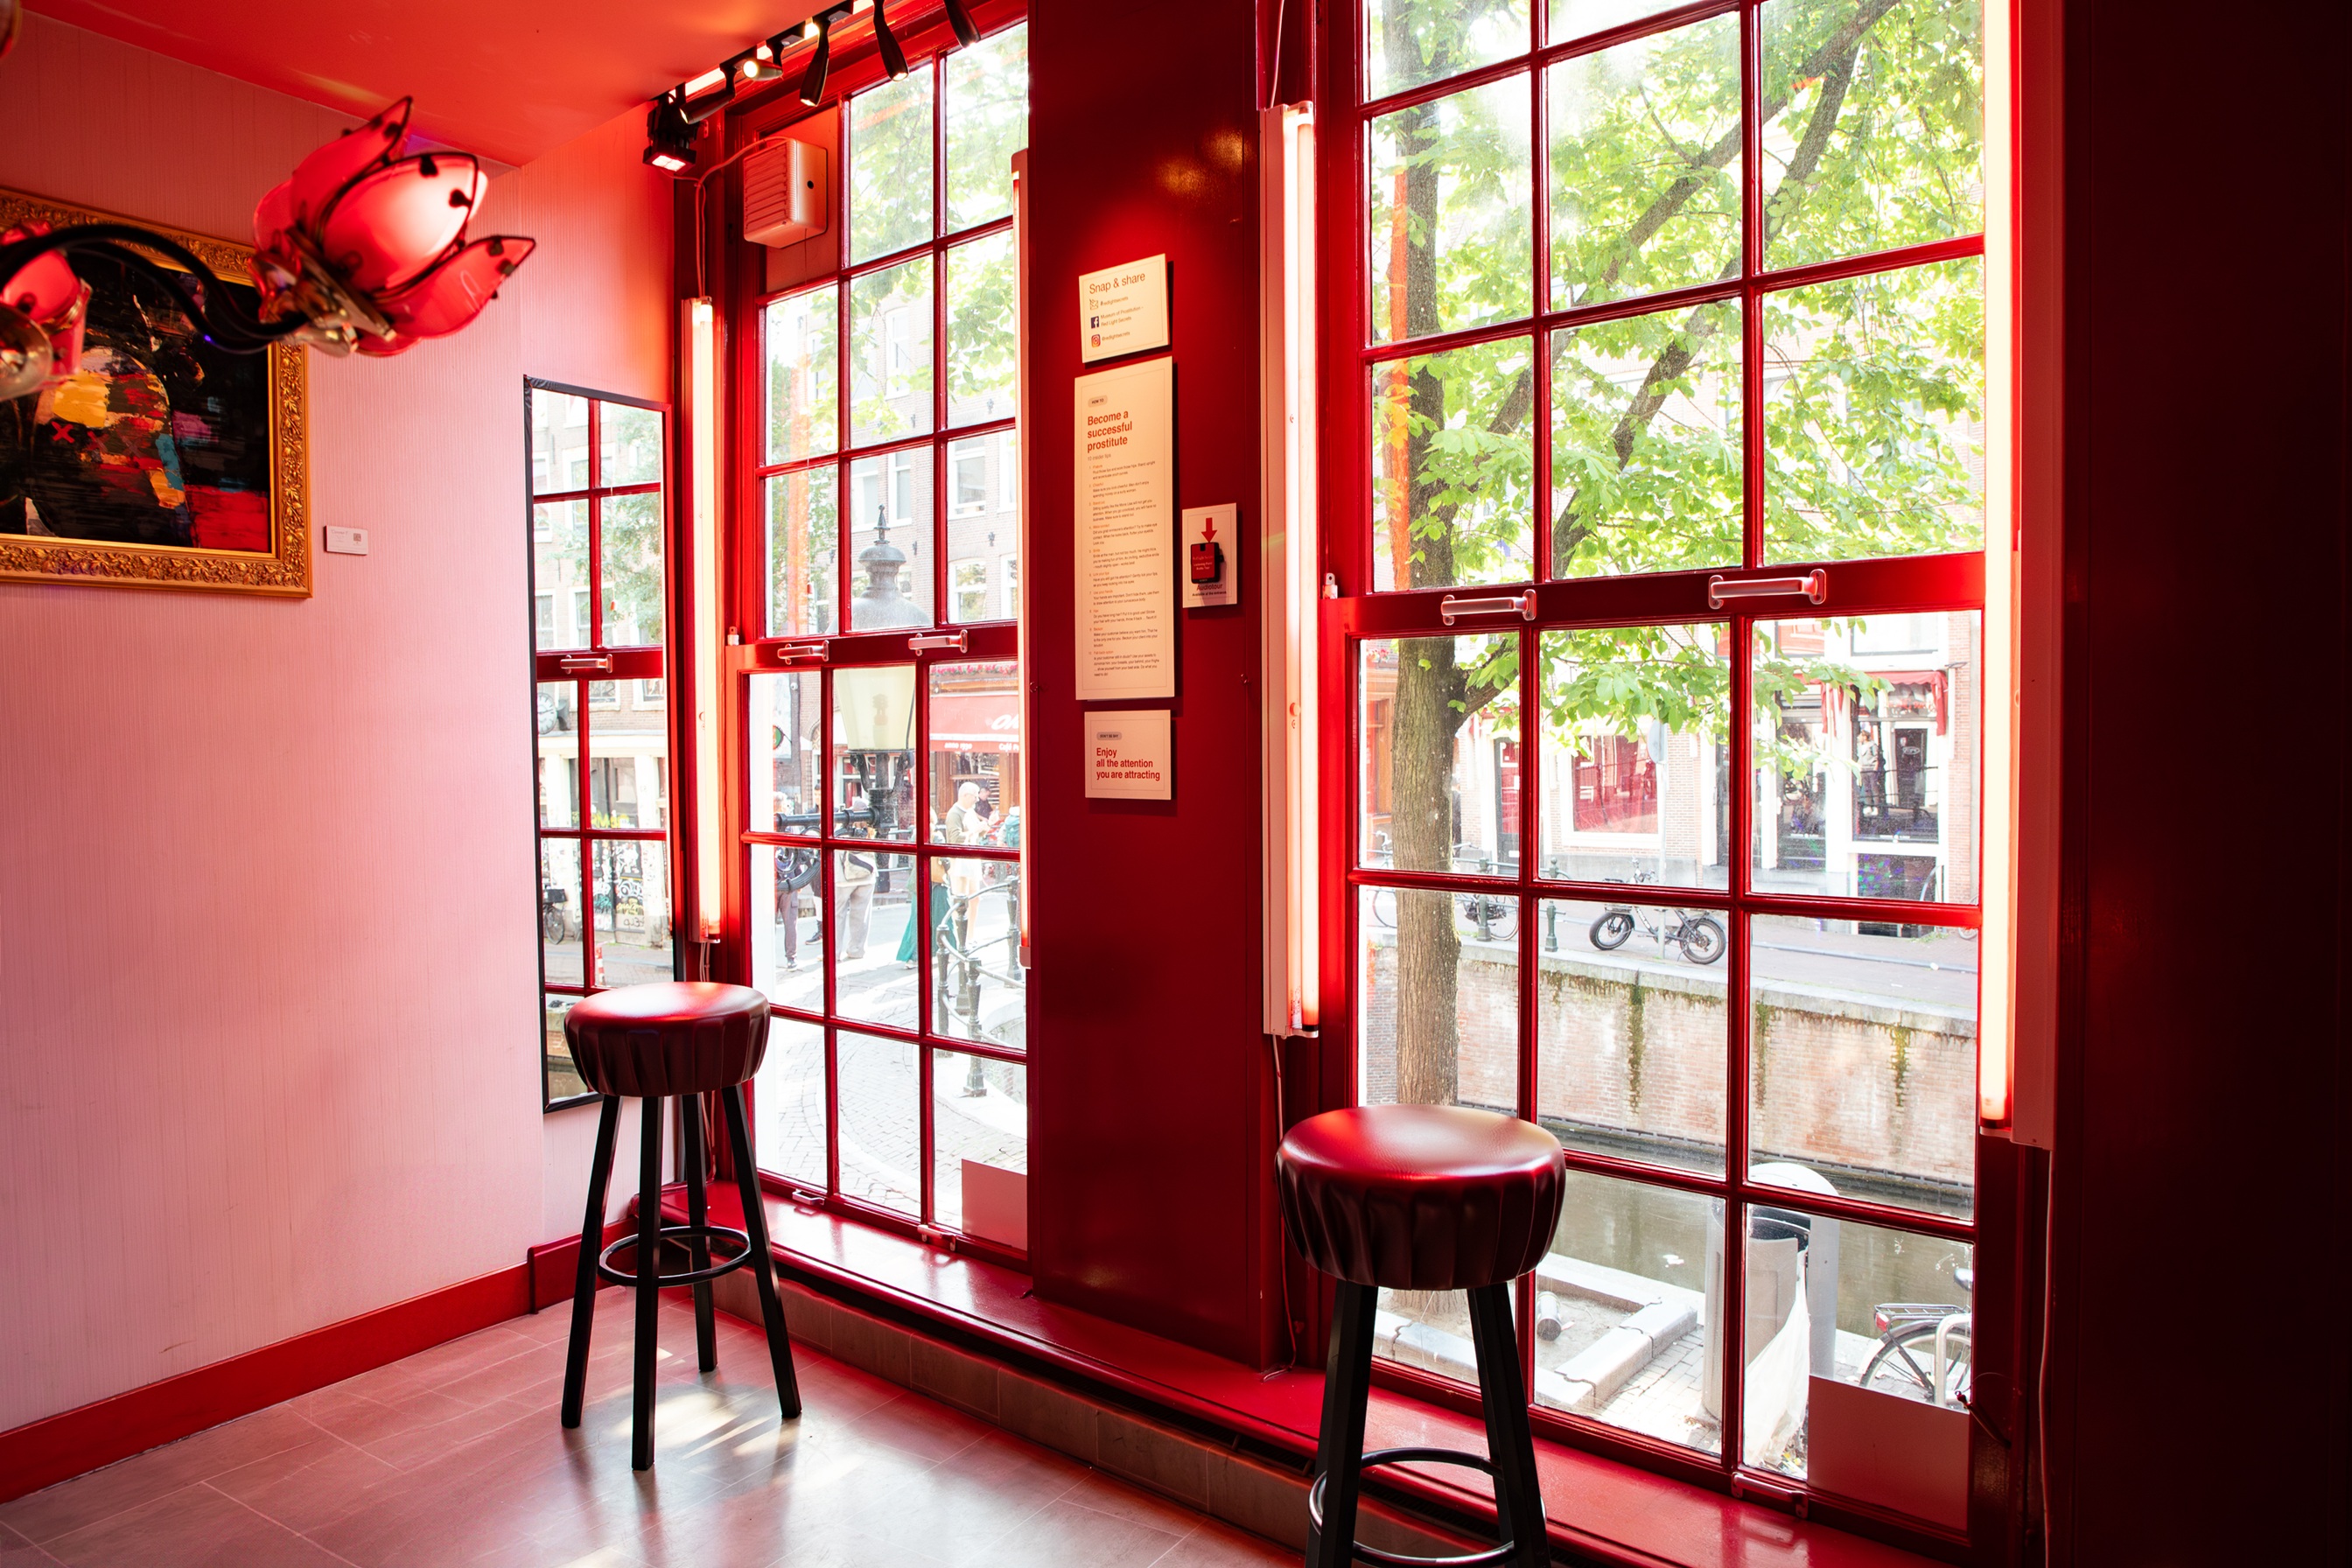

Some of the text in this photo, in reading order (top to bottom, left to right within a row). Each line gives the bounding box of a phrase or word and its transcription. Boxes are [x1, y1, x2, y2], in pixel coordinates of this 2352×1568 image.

[1089, 273, 1145, 294] Snap & share
[1088, 410, 1128, 426] Become a
[1087, 421, 1132, 438] successful
[1087, 436, 1128, 453] prostitute
[1096, 748, 1117, 758] Enjoy
[1107, 759, 1118, 767] the
[1120, 759, 1153, 768] attention
[1096, 771, 1110, 780] you
[1124, 770, 1160, 781] attracting
